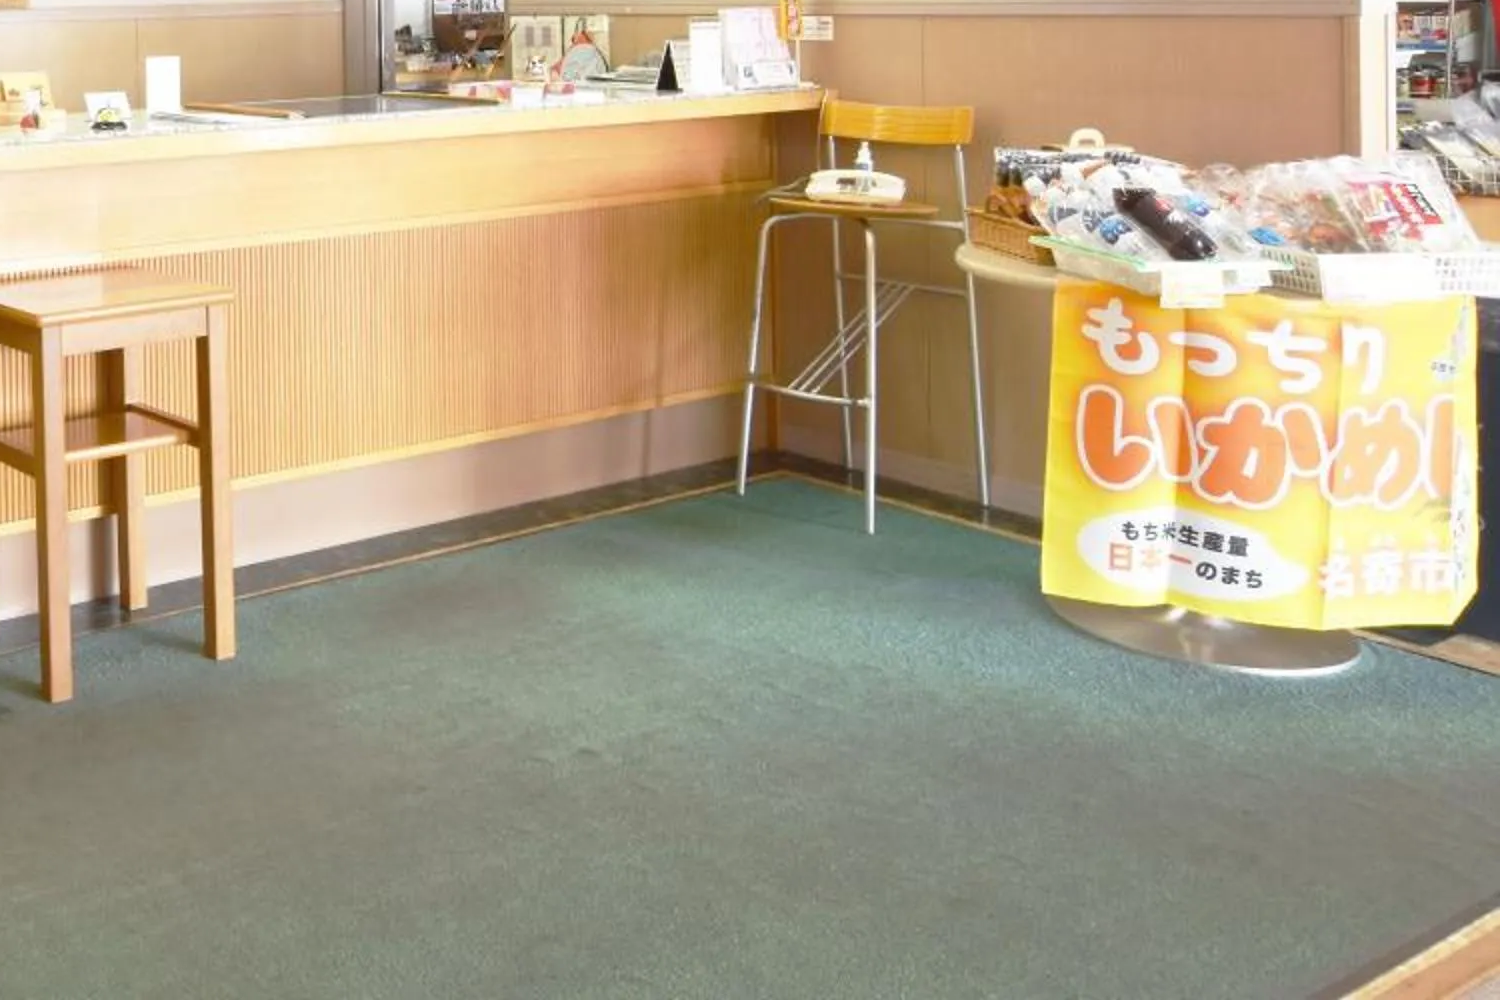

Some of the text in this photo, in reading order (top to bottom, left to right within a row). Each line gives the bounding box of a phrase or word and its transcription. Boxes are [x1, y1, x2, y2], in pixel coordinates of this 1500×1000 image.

[1081, 298, 1385, 396] もっちり
[1109, 542, 1263, 589] 日本一のまち
[1122, 521, 1249, 558] もち米生産量
[1319, 534, 1455, 599] 名寄市
